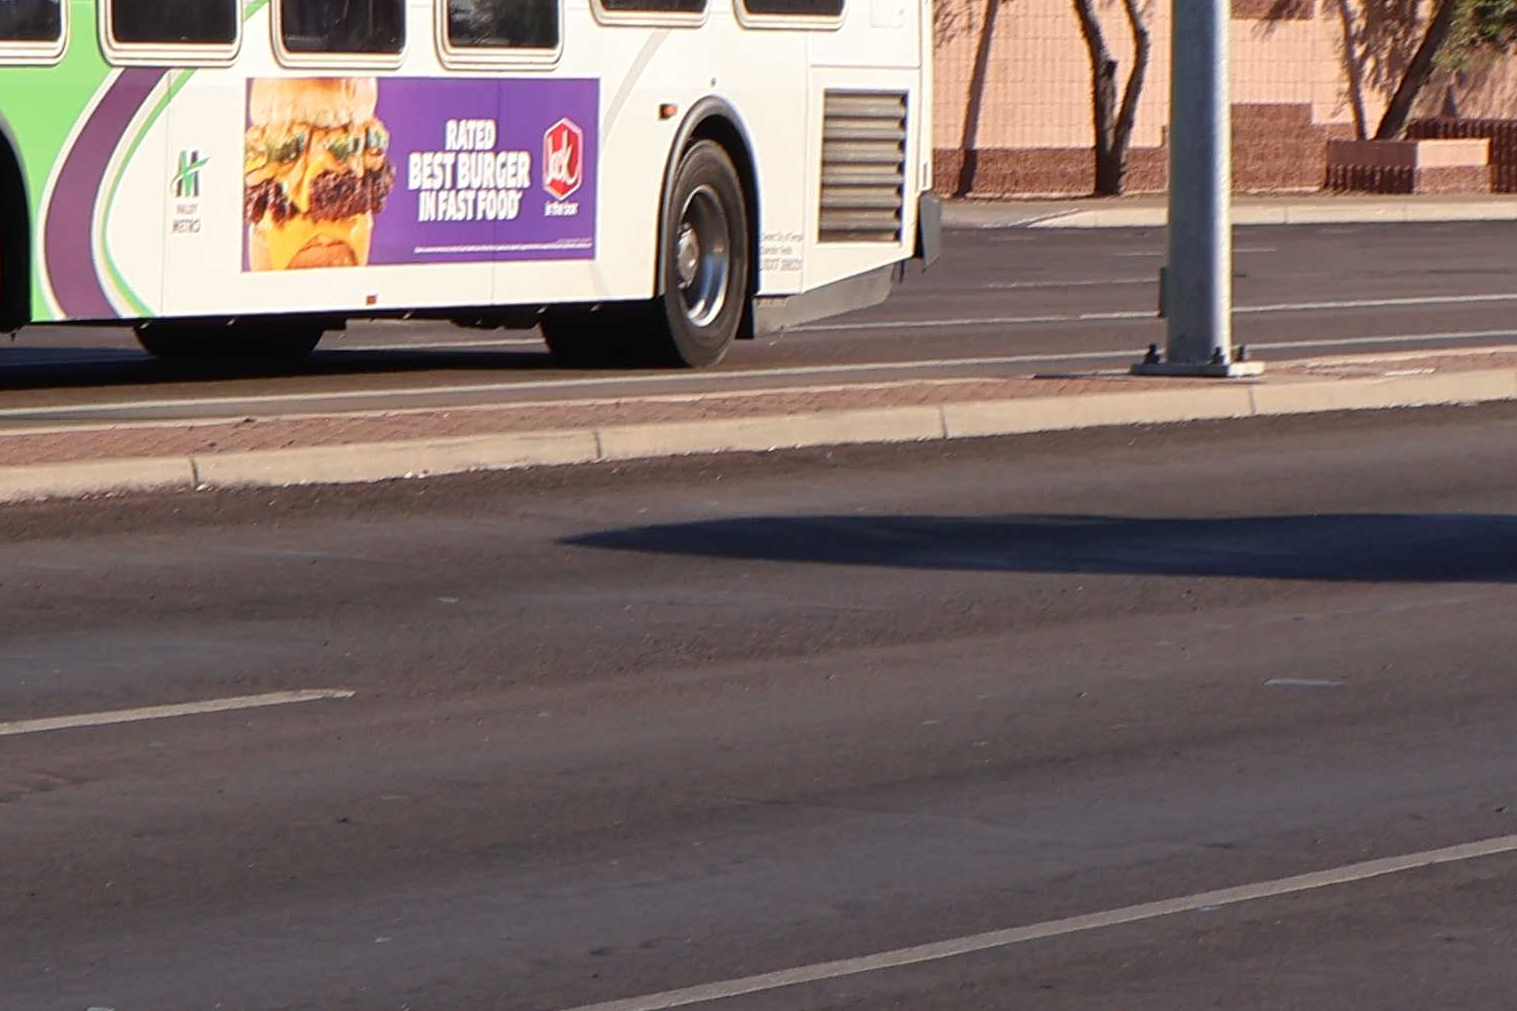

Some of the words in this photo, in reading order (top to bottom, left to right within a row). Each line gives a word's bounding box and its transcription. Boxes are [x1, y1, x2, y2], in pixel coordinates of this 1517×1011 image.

[445, 118, 497, 151] RATED
[408, 151, 456, 190] BEST
[456, 150, 532, 189] BURGER
[418, 191, 437, 222] IN
[437, 190, 476, 221] FAST
